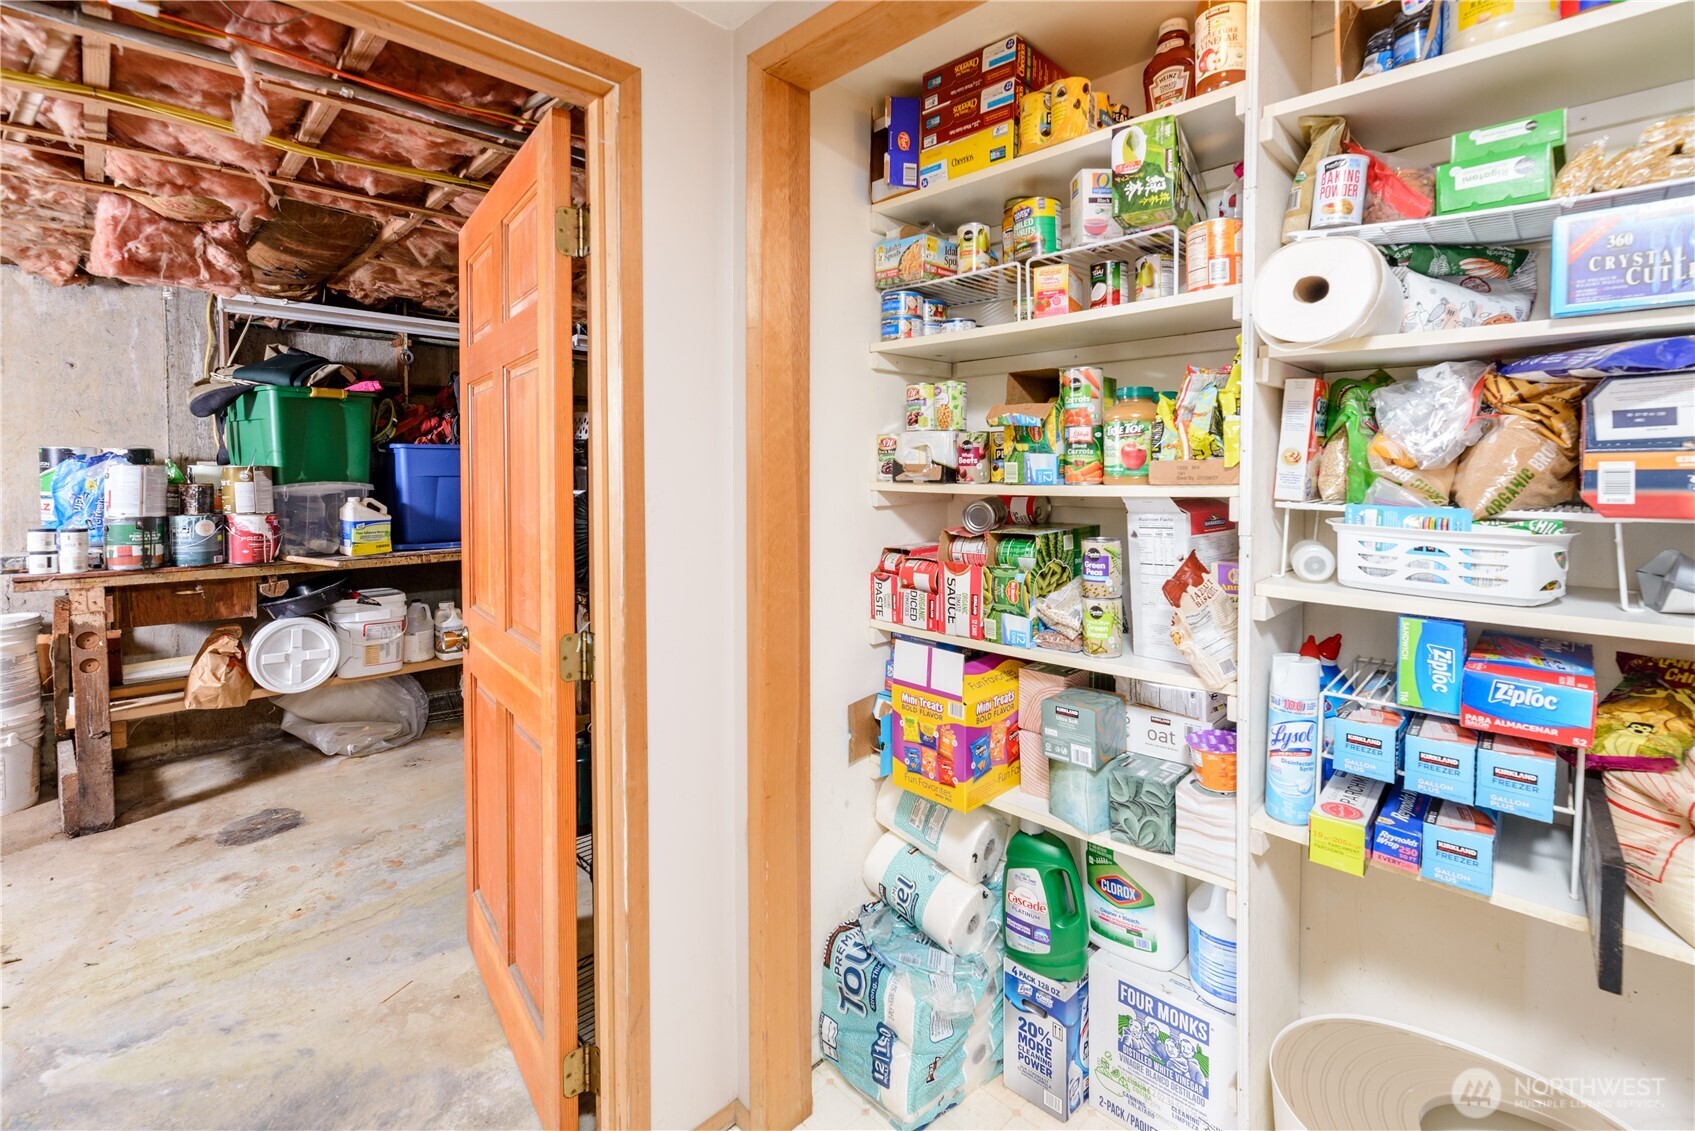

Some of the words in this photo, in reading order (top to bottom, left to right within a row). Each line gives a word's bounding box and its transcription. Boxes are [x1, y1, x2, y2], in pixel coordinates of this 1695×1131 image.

[1200, 33, 1238, 51] VINEGAR
[954, 57, 979, 72] Cheerios
[1159, 72, 1177, 83] HEINZ
[952, 98, 978, 114] Cheerios
[951, 153, 974, 168] Cheerios
[1321, 169, 1360, 186] BAKING
[1462, 168, 1509, 183] Rigatoni
[1320, 184, 1358, 200] POWDER
[1606, 232, 1634, 248] 360
[1588, 247, 1688, 272] CRYSTAL
[1065, 396, 1091, 404] Carrots
[1125, 422, 1145, 435] TOP
[1067, 448, 1094, 456] Carrots
[958, 457, 978, 465] Beets
[1043, 471, 1053, 483] 12
[1485, 468, 1535, 515] ORGANIC
[1084, 561, 1106, 570] Green
[876, 581, 884, 617] PASTE
[909, 590, 918, 622] DICED
[947, 577, 956, 624] SAUCE
[1086, 624, 1109, 632] Green
[1016, 632, 1026, 644] 12
[1402, 621, 1410, 660] SANDWICH
[1427, 646, 1451, 693] Ziploc
[901, 692, 918, 706] Mini
[919, 697, 944, 713] Treats
[976, 700, 992, 716] Mini
[993, 690, 1015, 708] Treats
[1494, 683, 1558, 711] Ziploc
[901, 704, 918, 714] BOLD
[919, 708, 943, 721] FLAVOR
[976, 712, 992, 725] BOLD
[993, 703, 1015, 717] FLAVOR
[1056, 706, 1079, 716] KIRKLAND
[1150, 716, 1171, 725] KIRKLAND
[1465, 713, 1492, 725] PARA
[1494, 718, 1559, 736] ALMACENAR
[1147, 729, 1176, 746] oat
[1270, 723, 1315, 751] Lysol
[1347, 734, 1382, 747] KIRKLAND
[1572, 737, 1588, 747] 52
[1345, 743, 1384, 757] FREEZER
[1344, 758, 1377, 771] GALLON
[1420, 753, 1459, 766] KIRKLAND
[998, 770, 1010, 784] Fun
[1344, 764, 1365, 774] PLUS
[1417, 762, 1461, 777] FREEZER
[1494, 767, 1538, 782] KIRKLAND
[904, 772, 917, 784] Fun
[918, 778, 952, 799] Favorites
[1340, 774, 1370, 806] PARCHM
[1417, 778, 1454, 792] GALLON
[1417, 784, 1441, 795] PLUS
[1492, 777, 1540, 794] FREEZER
[1490, 794, 1530, 809] GALLON
[1490, 801, 1516, 812] PLUS
[1376, 836, 1400, 850] Wrap
[1380, 831, 1419, 847] Reynolds
[1399, 845, 1418, 856] 250
[1437, 840, 1478, 856] KIRKLAND
[1435, 851, 1480, 868] FREEZER
[1434, 866, 1471, 882] GALLON
[1434, 873, 1458, 884] PLUS
[1101, 879, 1136, 900] CLOROX
[1007, 891, 1047, 914] Cascade
[1011, 906, 1041, 920] PLATINUM
[1012, 966, 1018, 976] 4
[1019, 971, 1036, 984] PACK
[1038, 980, 1050, 991] 128
[1051, 987, 1061, 997] OZ
[1120, 984, 1155, 1016] FOUR
[1158, 1002, 1208, 1042] MONKS
[1018, 1016, 1053, 1047] 20%
[1018, 1031, 1053, 1061] MORE
[1018, 1044, 1053, 1068] CLEANING
[873, 1063, 884, 1081] 12
[1018, 1054, 1053, 1080] POWER
[1122, 1044, 1153, 1068] DISTILLED
[1154, 1061, 1174, 1079] WHITE
[1175, 1073, 1204, 1096] VINEGAR
[1119, 1053, 1145, 1074] VINAGRE
[1146, 1068, 1170, 1089] BLANCO
[1171, 1080, 1206, 1108] DESTILADO
[1122, 1091, 1146, 1109] CANNING
[1099, 1096, 1126, 1123] 2-PACK
[1128, 1100, 1155, 1119] ENLATADO
[1171, 1106, 1200, 1126] CLEANING
[1171, 1113, 1199, 1131] LIMPIEZA
